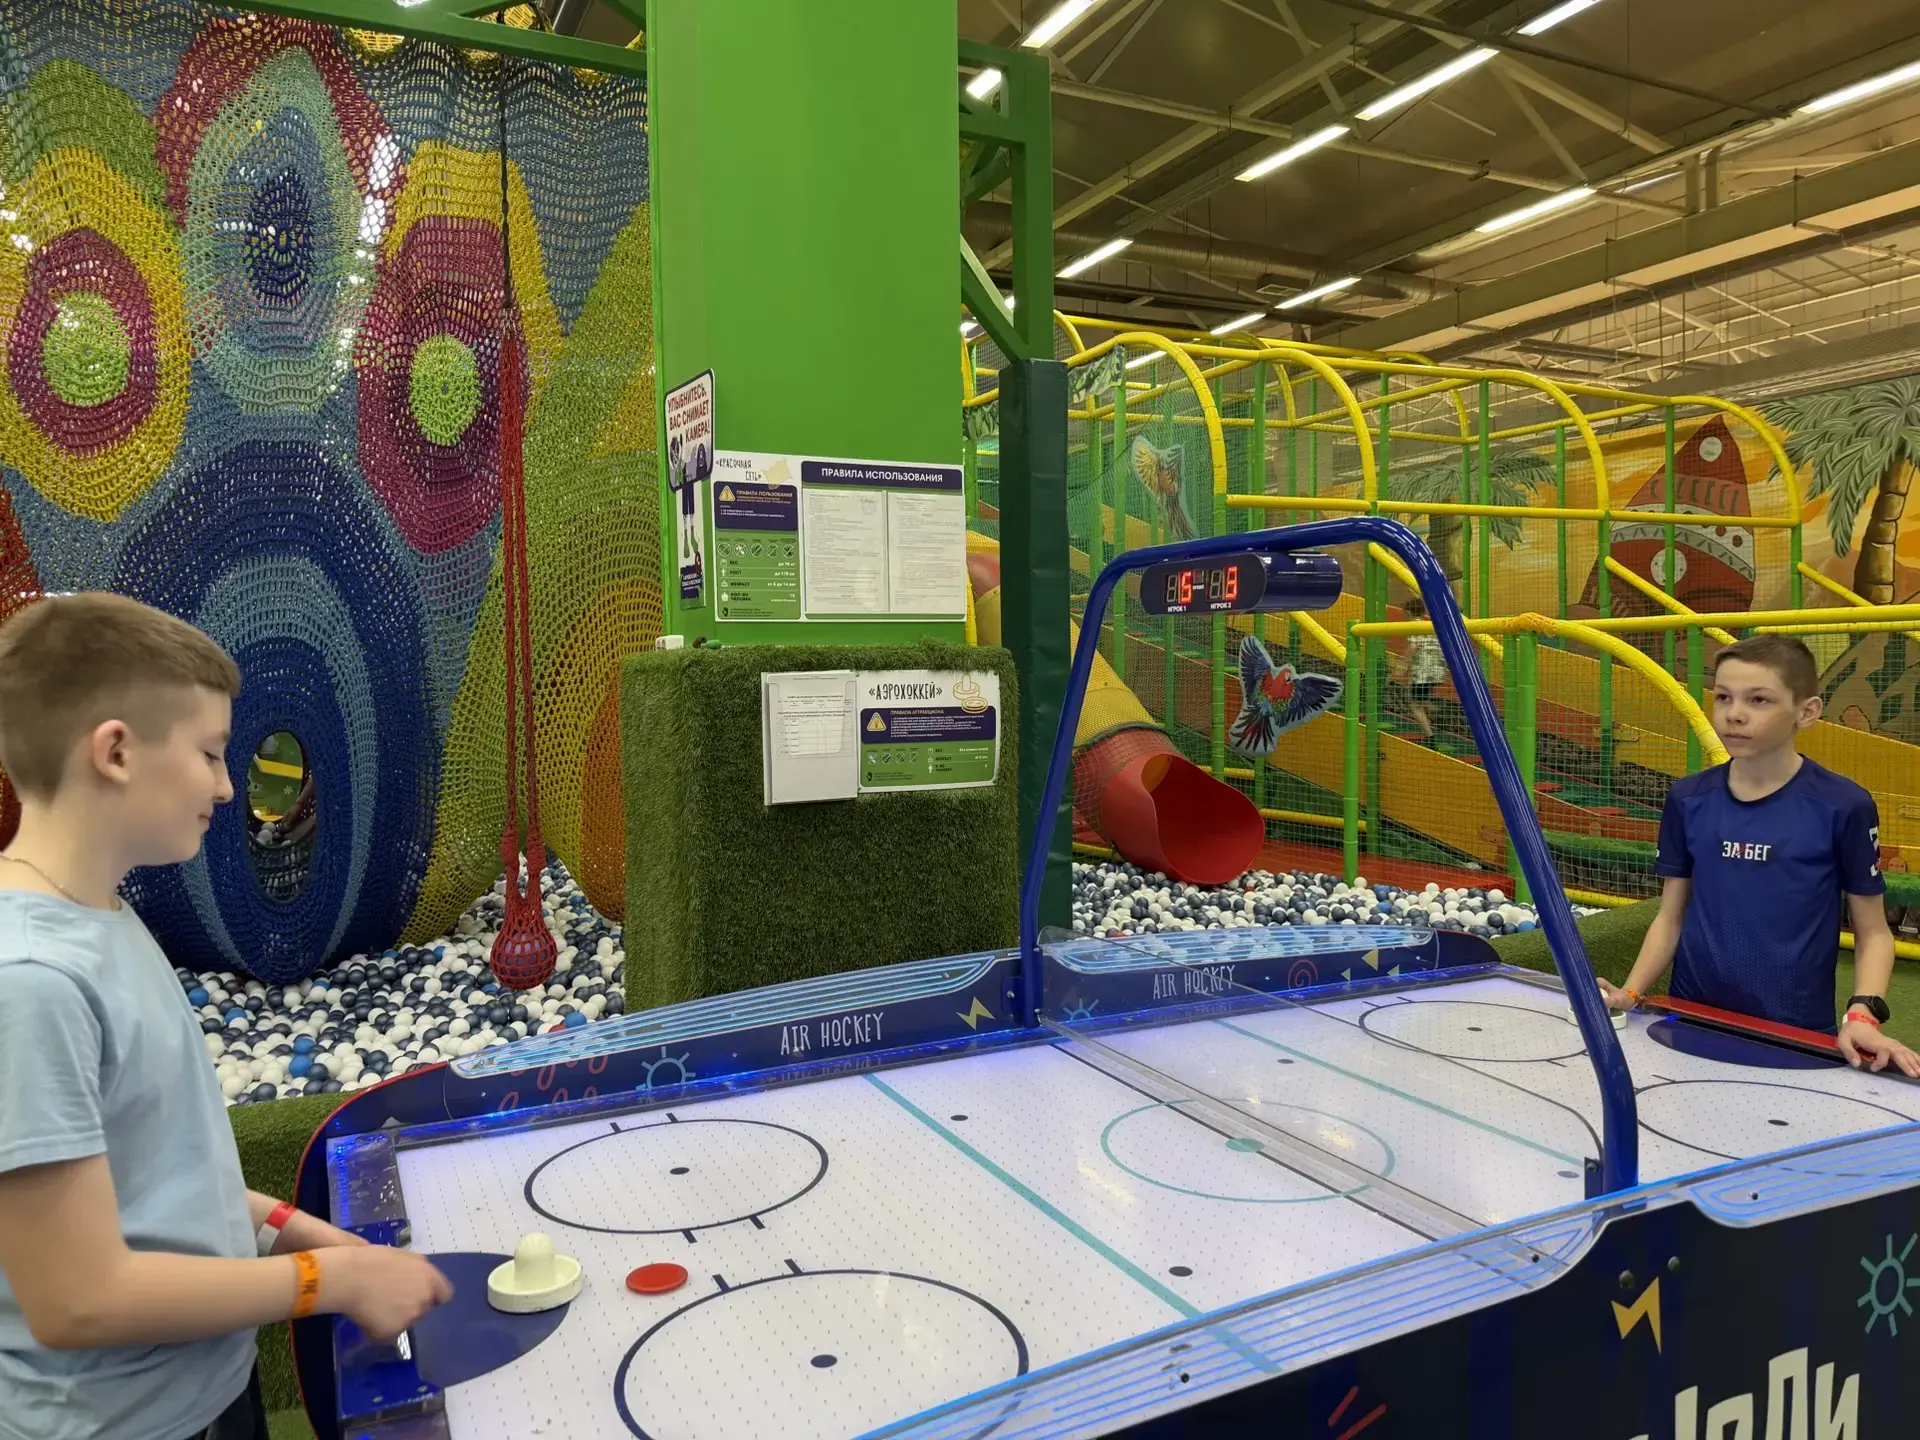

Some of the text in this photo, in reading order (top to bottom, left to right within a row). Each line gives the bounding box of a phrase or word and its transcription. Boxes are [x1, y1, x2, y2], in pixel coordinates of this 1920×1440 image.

[670, 400, 709, 430] ВАС СНИМАЕТ
[685, 419, 710, 443] КАМЕРА!
[821, 467, 943, 482] ПРАВИЛА ИСПОЛЬЗОВАНИЯ
[868, 681, 943, 701] «АЭРОХОККЕЙ»
[1722, 840, 1771, 861] ЗАБЕГ
[1152, 964, 1236, 1000] AIR HOCKEY
[780, 1012, 884, 1056] AIR HOCKEY
